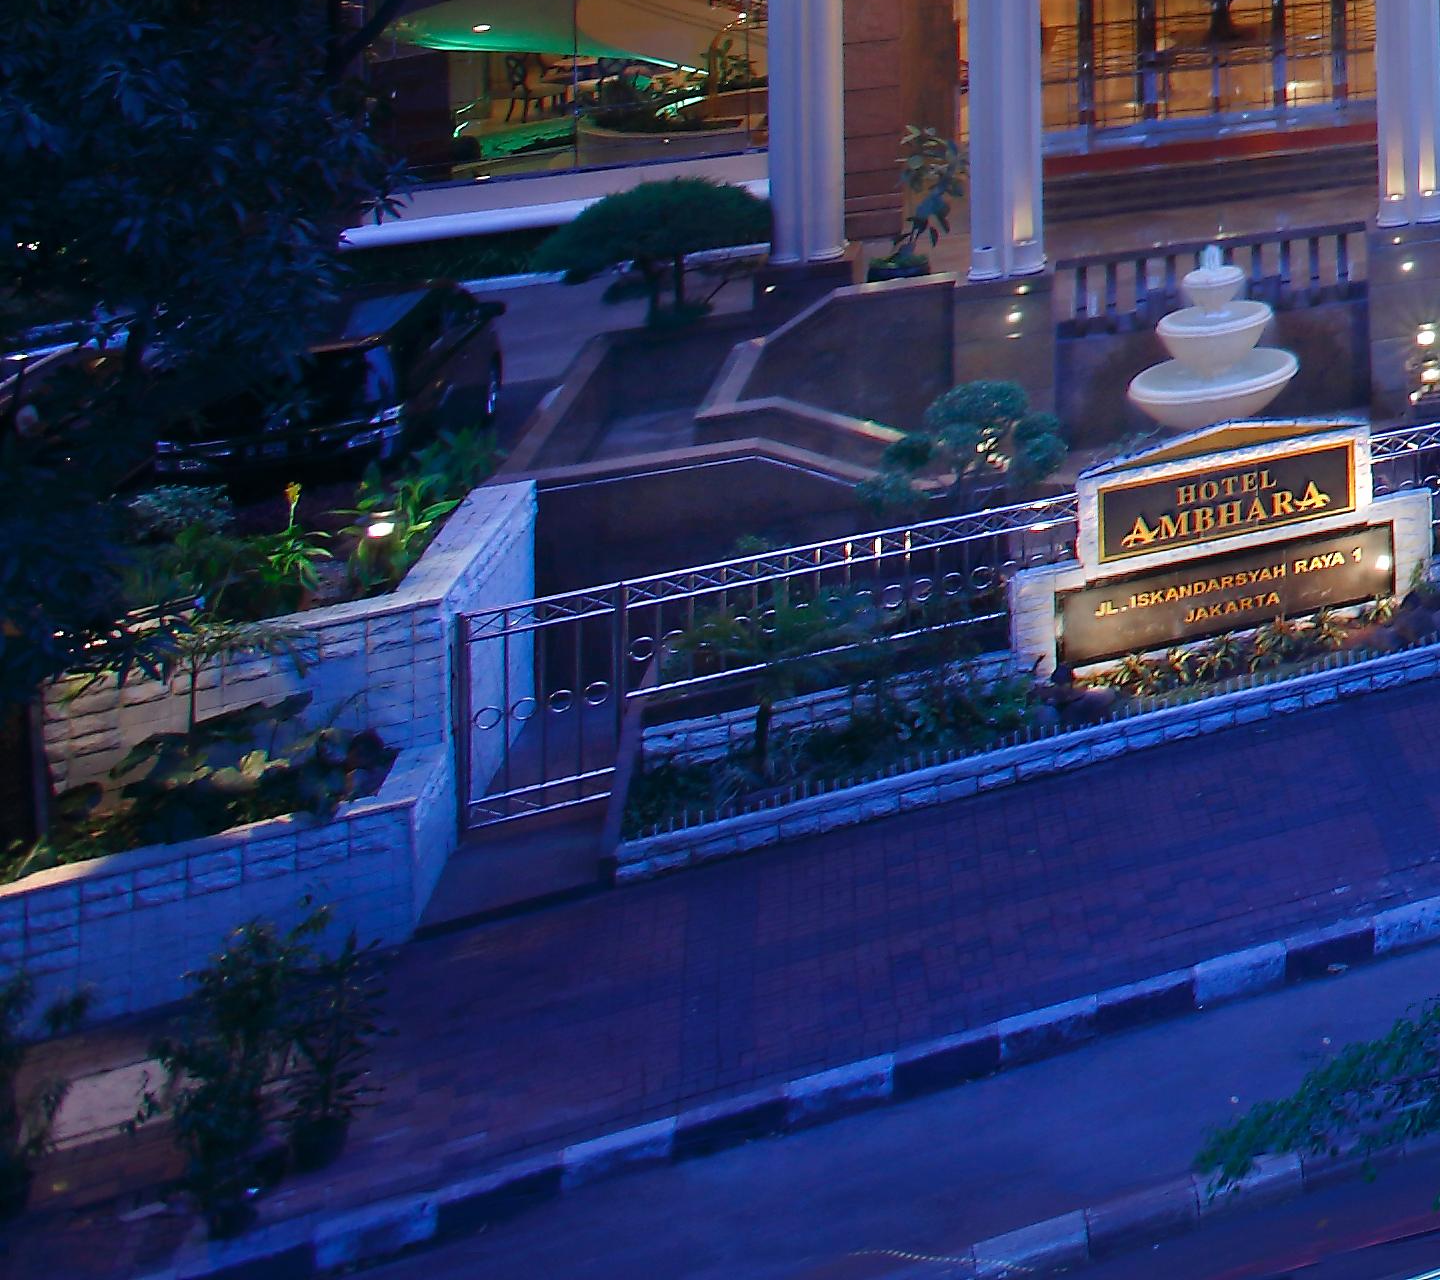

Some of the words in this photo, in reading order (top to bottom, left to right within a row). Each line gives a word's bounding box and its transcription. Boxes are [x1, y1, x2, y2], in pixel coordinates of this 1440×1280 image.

[1176, 469, 1277, 507] HOTEL
[1121, 480, 1331, 549] AMBHARA
[1294, 550, 1346, 575] RAYA
[1350, 546, 1362, 564] 1
[1184, 591, 1281, 624] JAKARTA
